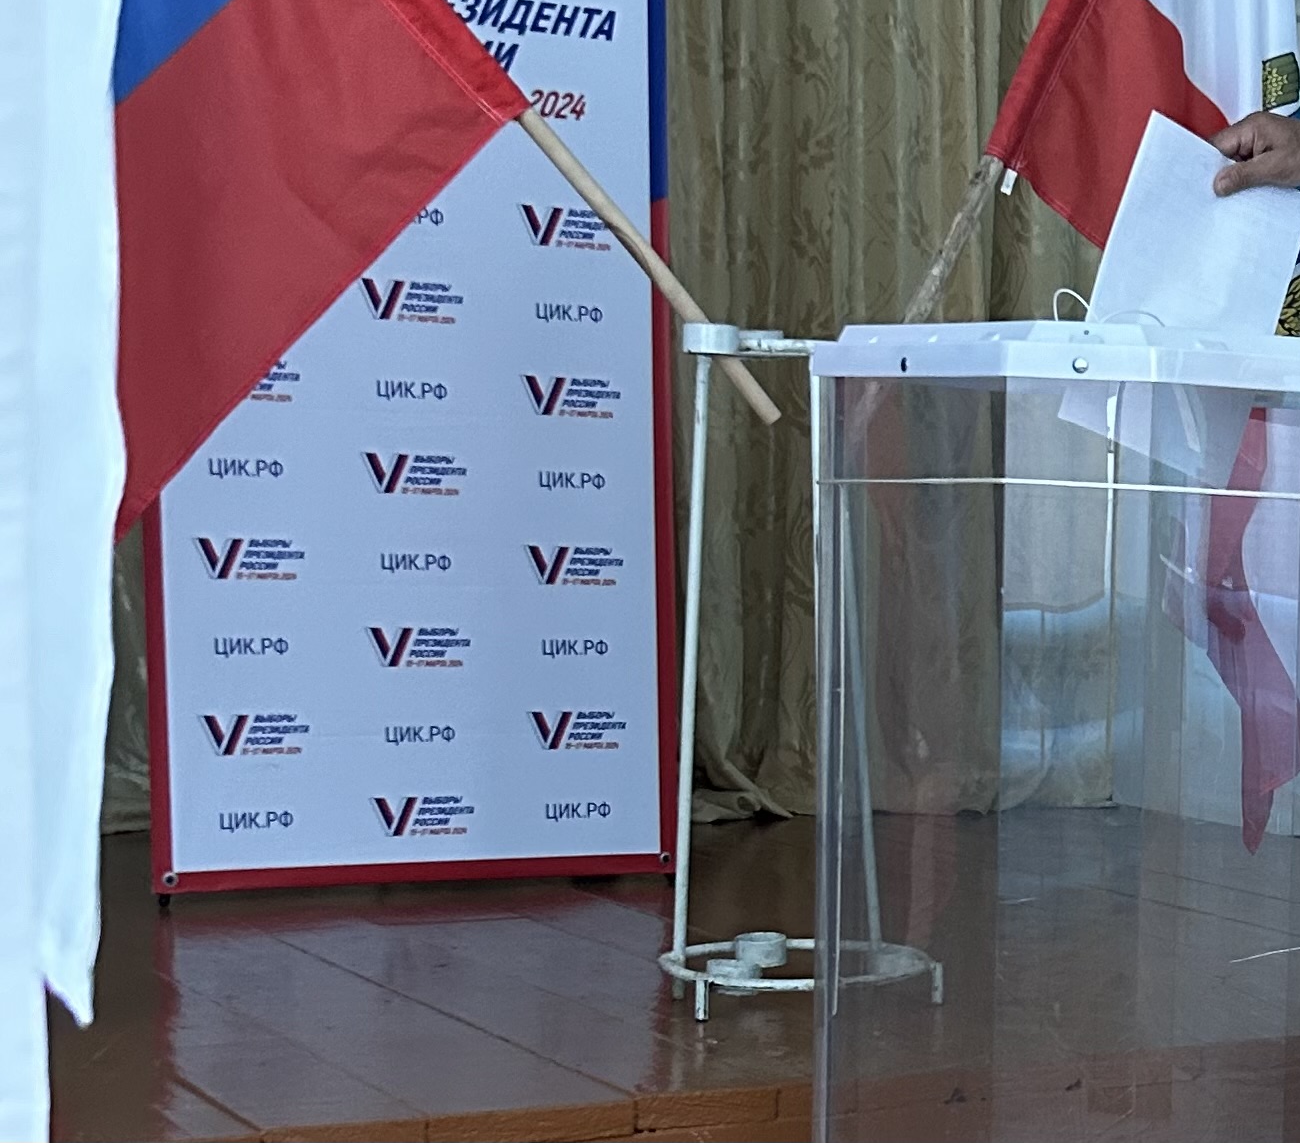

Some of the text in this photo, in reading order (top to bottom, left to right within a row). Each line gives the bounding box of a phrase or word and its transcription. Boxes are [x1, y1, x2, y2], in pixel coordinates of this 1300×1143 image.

[530, 89, 587, 121] 2024
[536, 303, 603, 323] ЦИК.РФ
[377, 380, 448, 401] ЦИК.РФ
[209, 458, 284, 479] ЦИК.РФ
[539, 471, 606, 491] ЦИК.РФ
[381, 554, 451, 573] ЦИК.РФ
[214, 638, 289, 658] ЦИК.РФ
[542, 639, 609, 659] ЦИК.РФ
[385, 725, 456, 746] ЦИК.РФ
[219, 811, 294, 833] ЦИК.РФ
[545, 801, 611, 822] ЦИК.РФ
